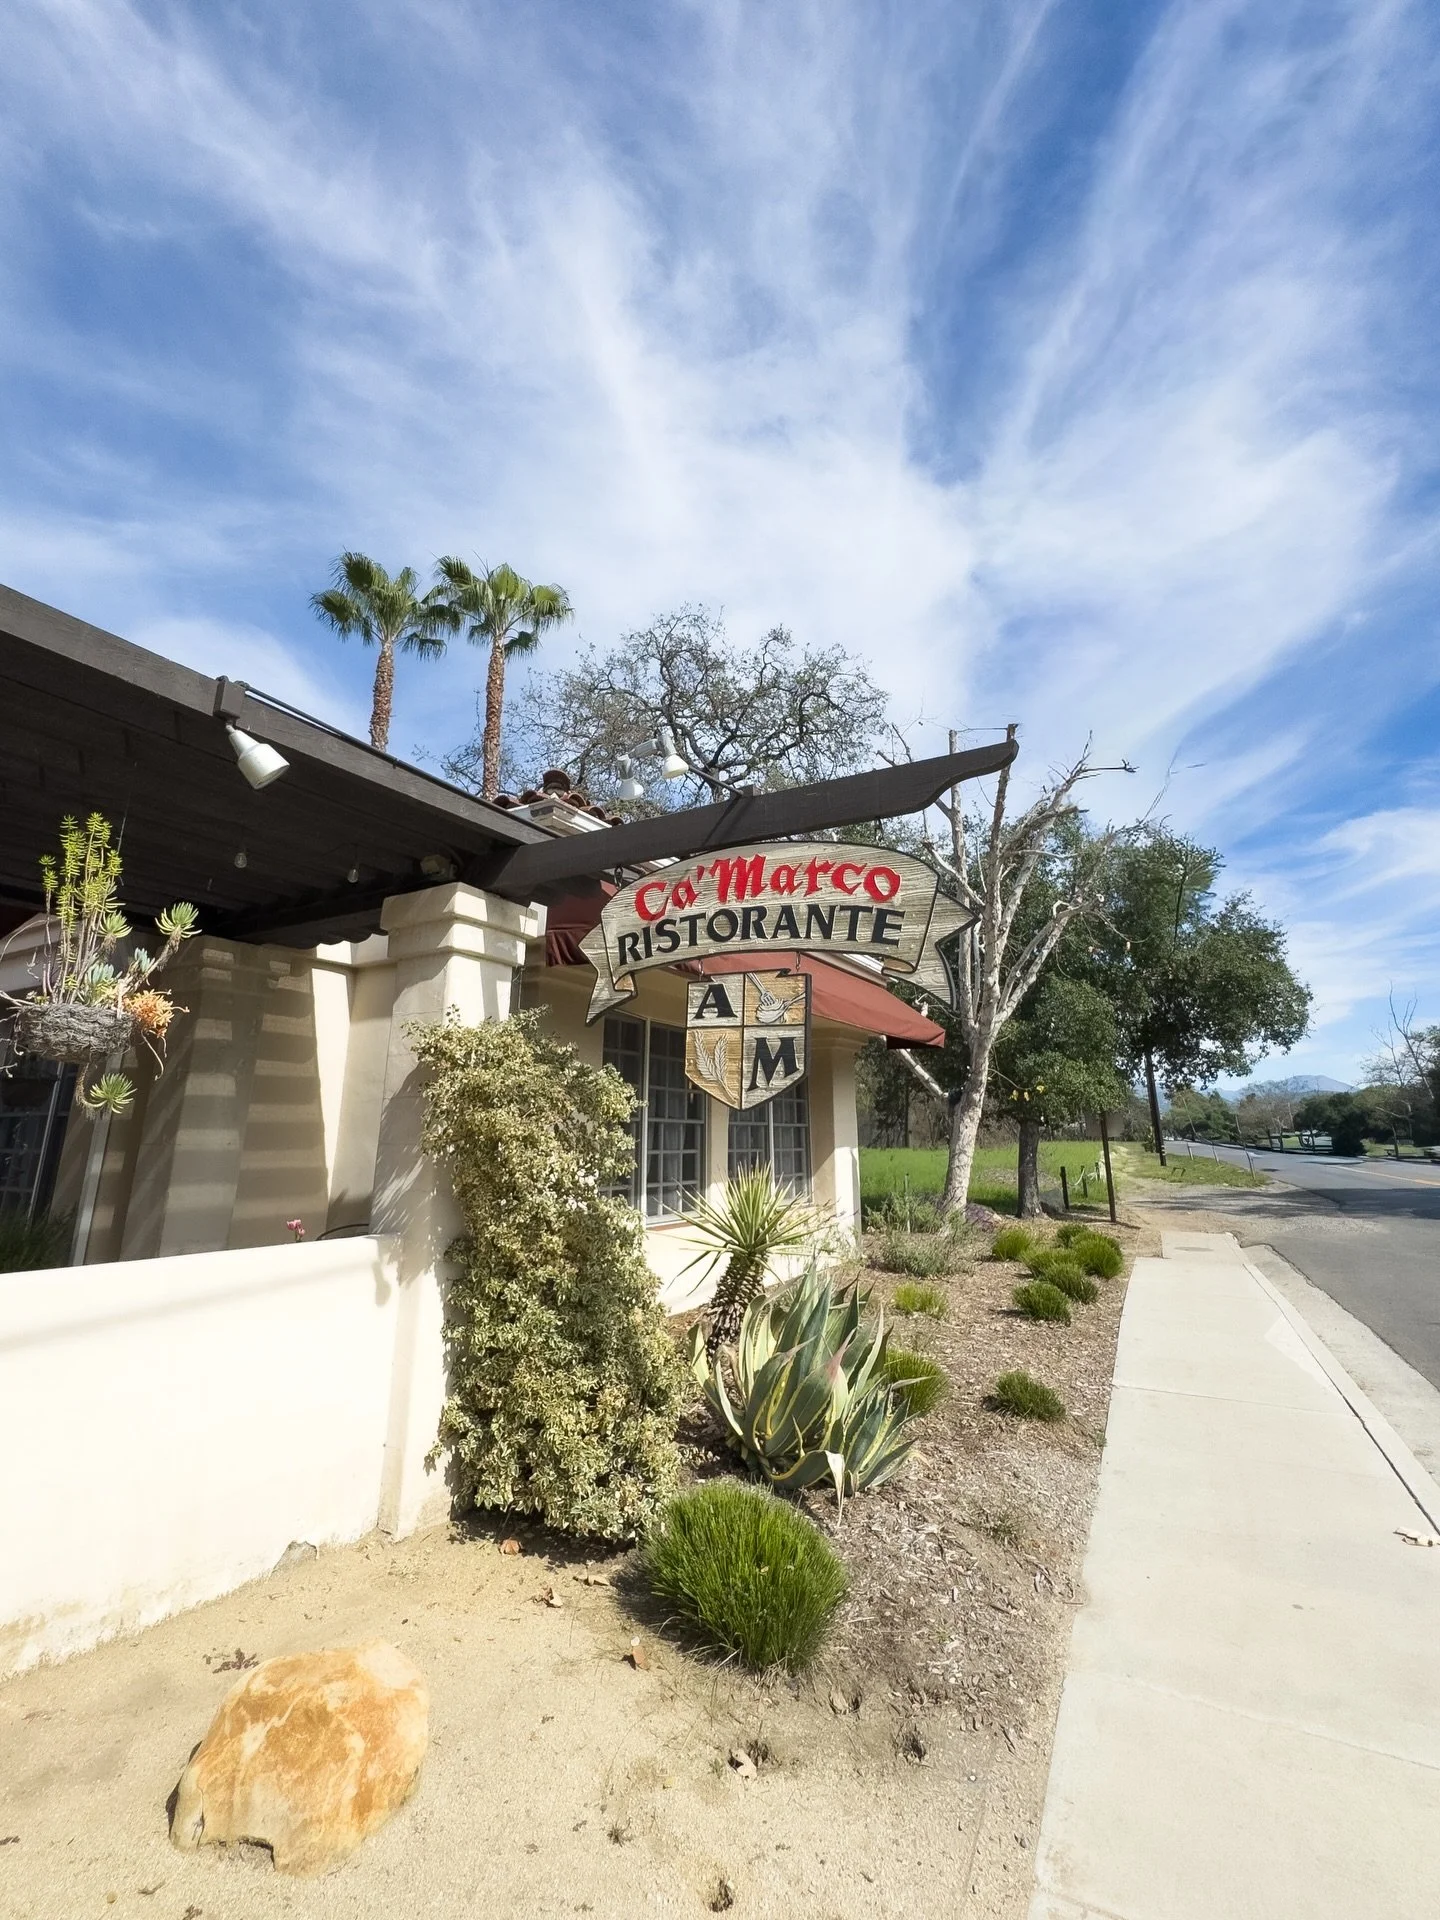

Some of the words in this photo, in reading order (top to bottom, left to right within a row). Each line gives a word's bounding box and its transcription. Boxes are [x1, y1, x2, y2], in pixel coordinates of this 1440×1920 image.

[617, 904, 905, 965] RISTORANTE
[692, 983, 738, 1020] A
[747, 1036, 799, 1091] M
